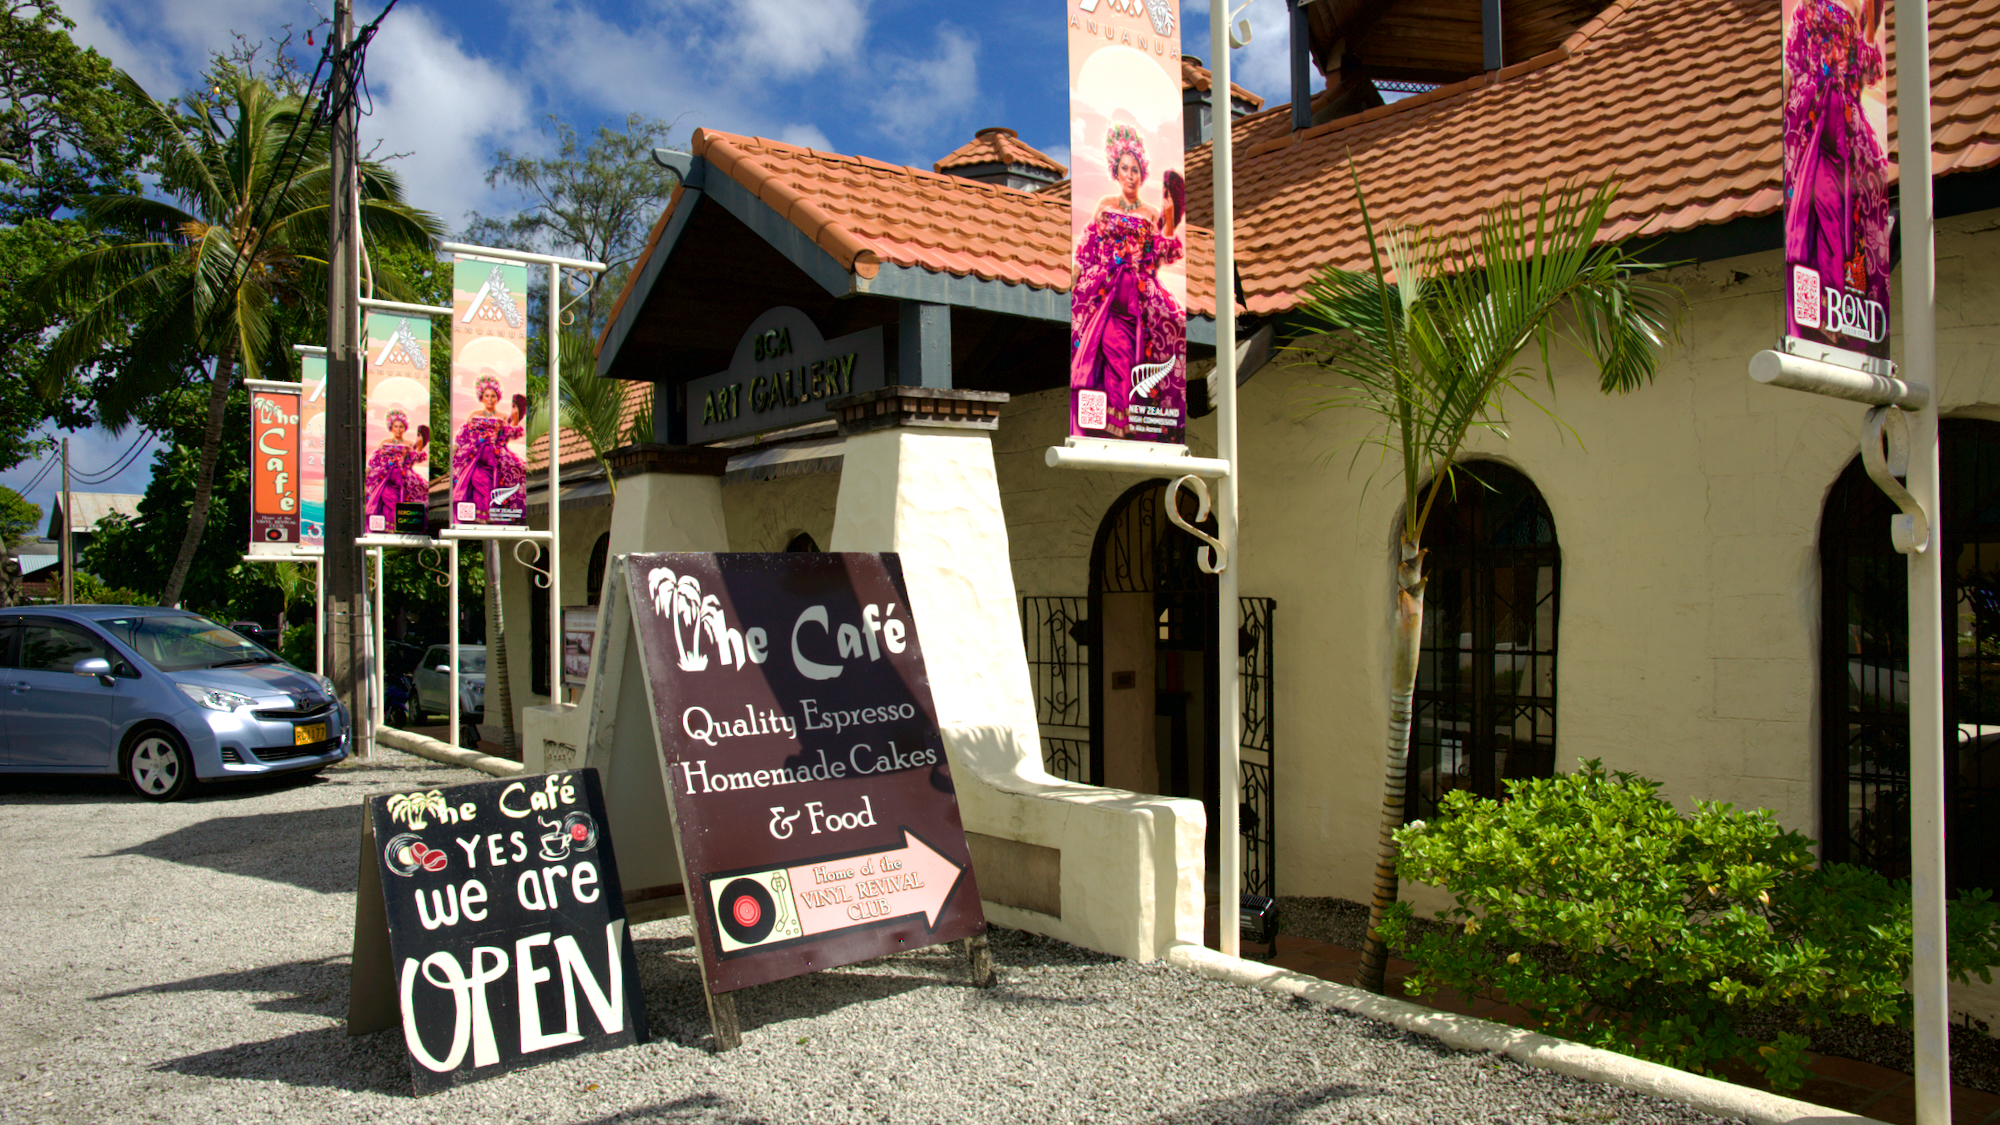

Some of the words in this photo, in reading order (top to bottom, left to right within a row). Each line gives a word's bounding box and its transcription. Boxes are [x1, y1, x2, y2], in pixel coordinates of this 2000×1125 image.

[1070, 13, 1179, 60] ANUANUA
[455, 325, 525, 339] ANUANUA
[1825, 286, 1887, 343] BOND
[754, 326, 792, 361] BCA
[368, 368, 429, 379] ANUANUA
[702, 383, 741, 425] ART
[750, 353, 858, 413] GALLERY
[1129, 404, 1146, 414] NEW
[1147, 406, 1179, 417] ZEALAND
[791, 603, 907, 680] Café
[297, 727, 325, 742] RC1177
[682, 704, 797, 746] Quality
[799, 699, 915, 734] Espresso
[680, 749, 846, 794] Homemade
[849, 741, 937, 775] Cakes
[499, 775, 576, 818] Café
[769, 806, 800, 839] &
[805, 795, 877, 835] Food
[456, 831, 528, 868] YES
[813, 866, 854, 885] Home
[860, 858, 874, 876] of
[880, 855, 902, 872] the
[415, 878, 488, 930] we
[517, 861, 600, 910] are
[800, 885, 852, 910] VINYL
[856, 872, 925, 899] REVIVAL
[847, 898, 891, 921] CLUB
[400, 918, 625, 1072] OPEN
